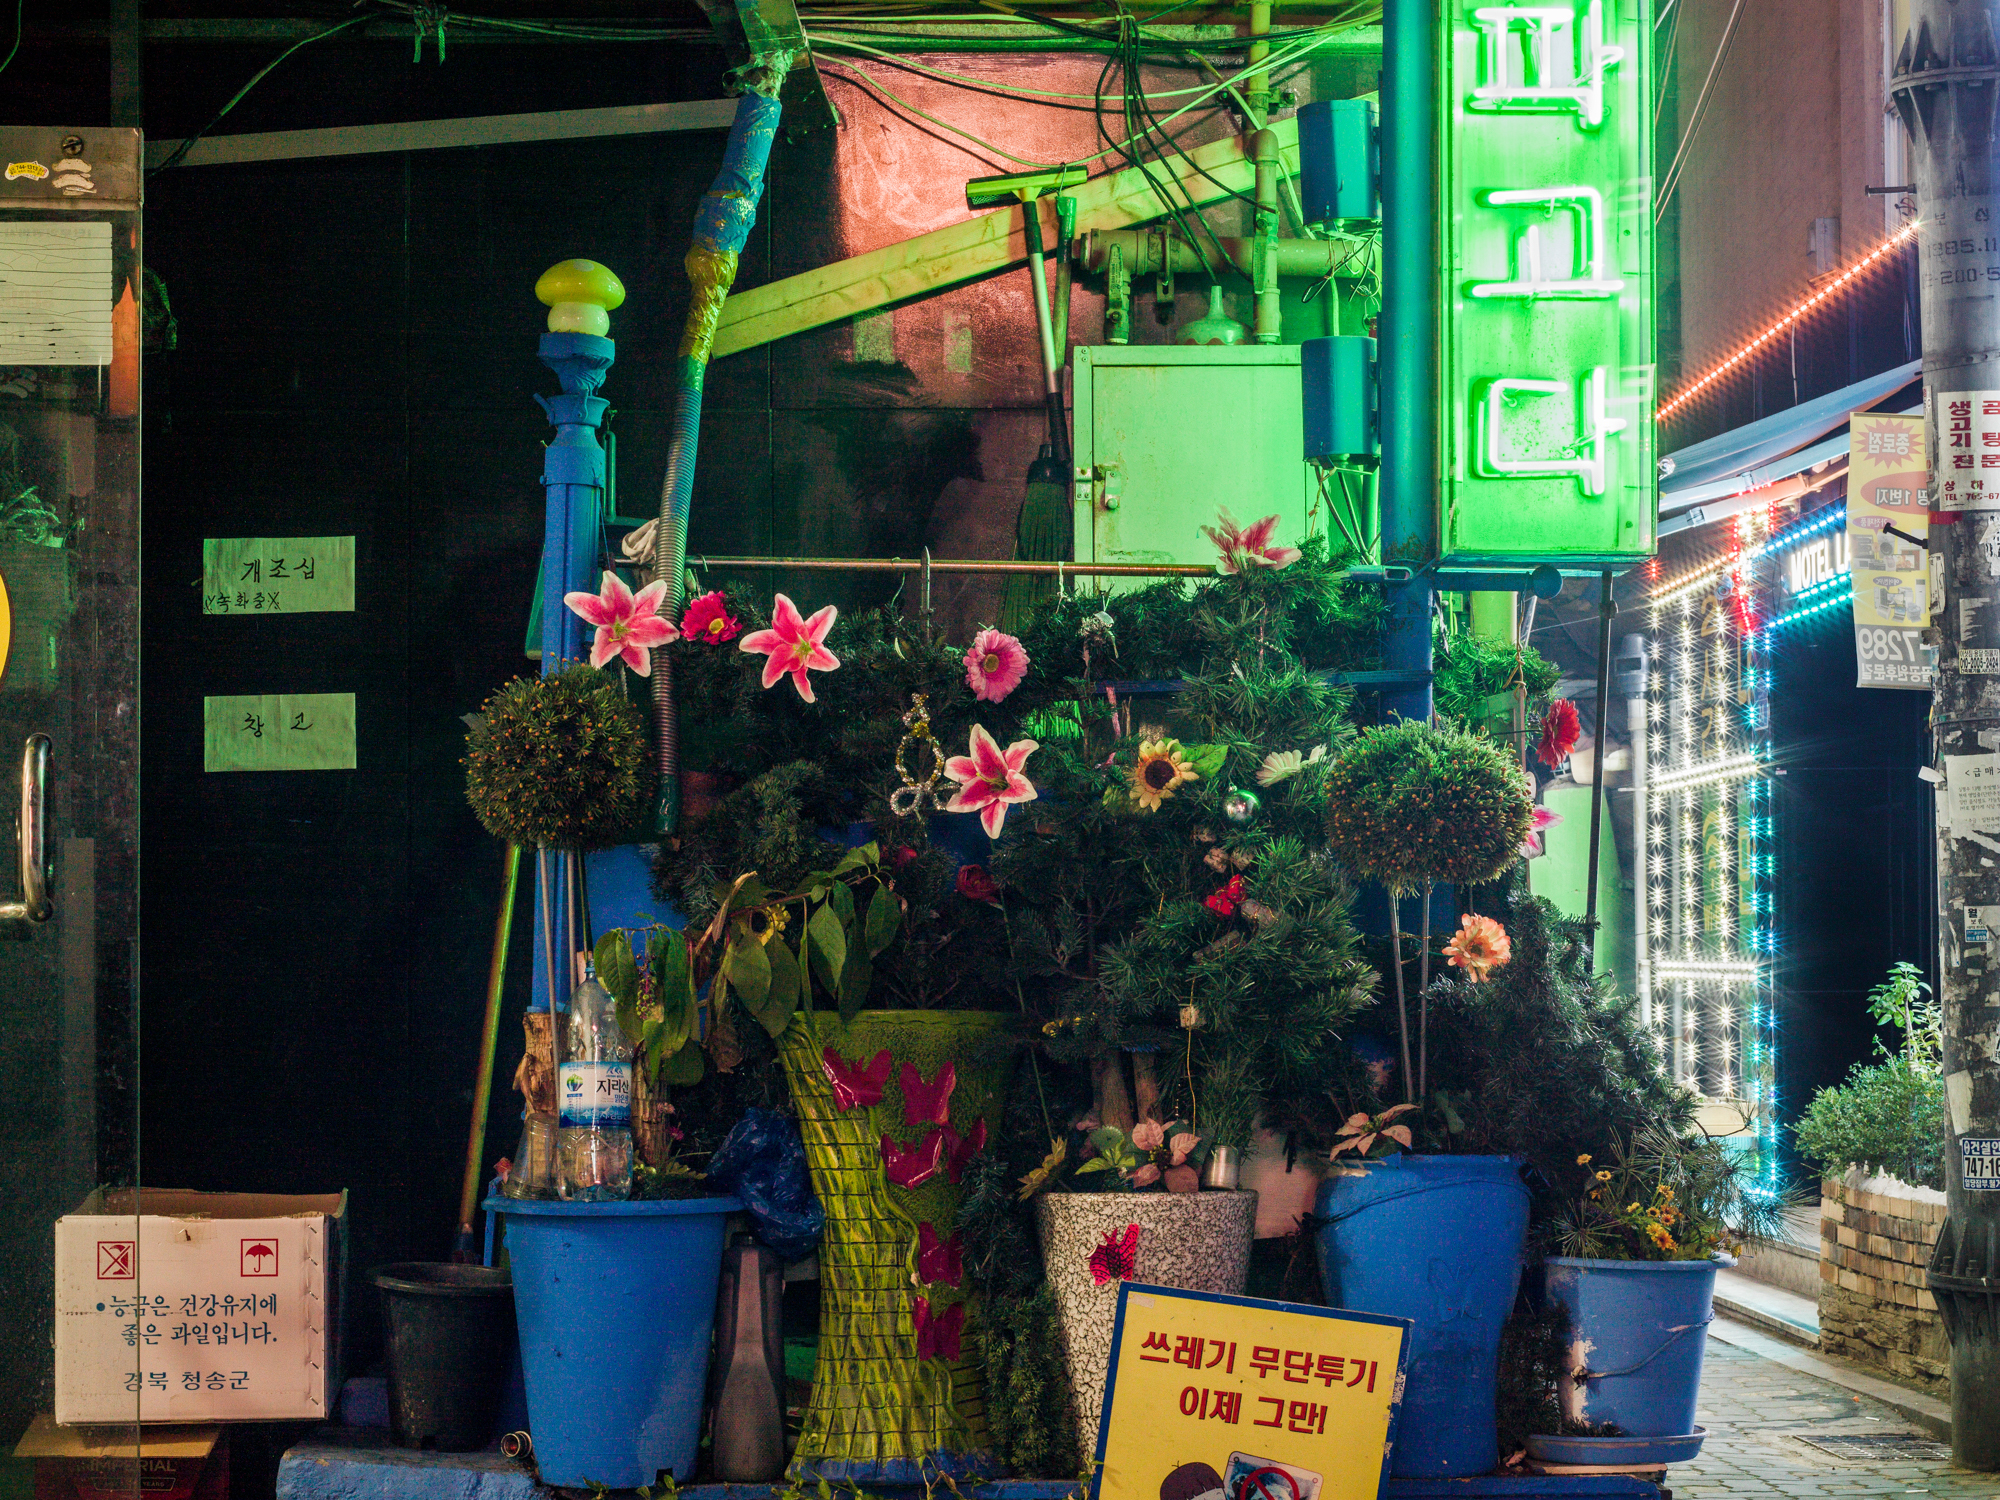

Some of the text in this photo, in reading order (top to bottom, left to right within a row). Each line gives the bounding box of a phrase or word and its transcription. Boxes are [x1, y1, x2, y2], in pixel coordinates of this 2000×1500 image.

[1472, 0, 1626, 495] 파고다
[1948, 400, 1972, 448] 생고기
[1945, 493, 1958, 501] TEL
[1791, 538, 1834, 593] MOTEL
[596, 1079, 629, 1096] 지리산
[109, 1293, 277, 1318] 능금은 건강유지에
[121, 1321, 277, 1347] 좋은 과일입니다.
[1140, 1331, 1379, 1394] 쓰레기 무단투기
[123, 1371, 250, 1392] 경북 청송군
[1179, 1385, 1329, 1435] 이제 그만!
